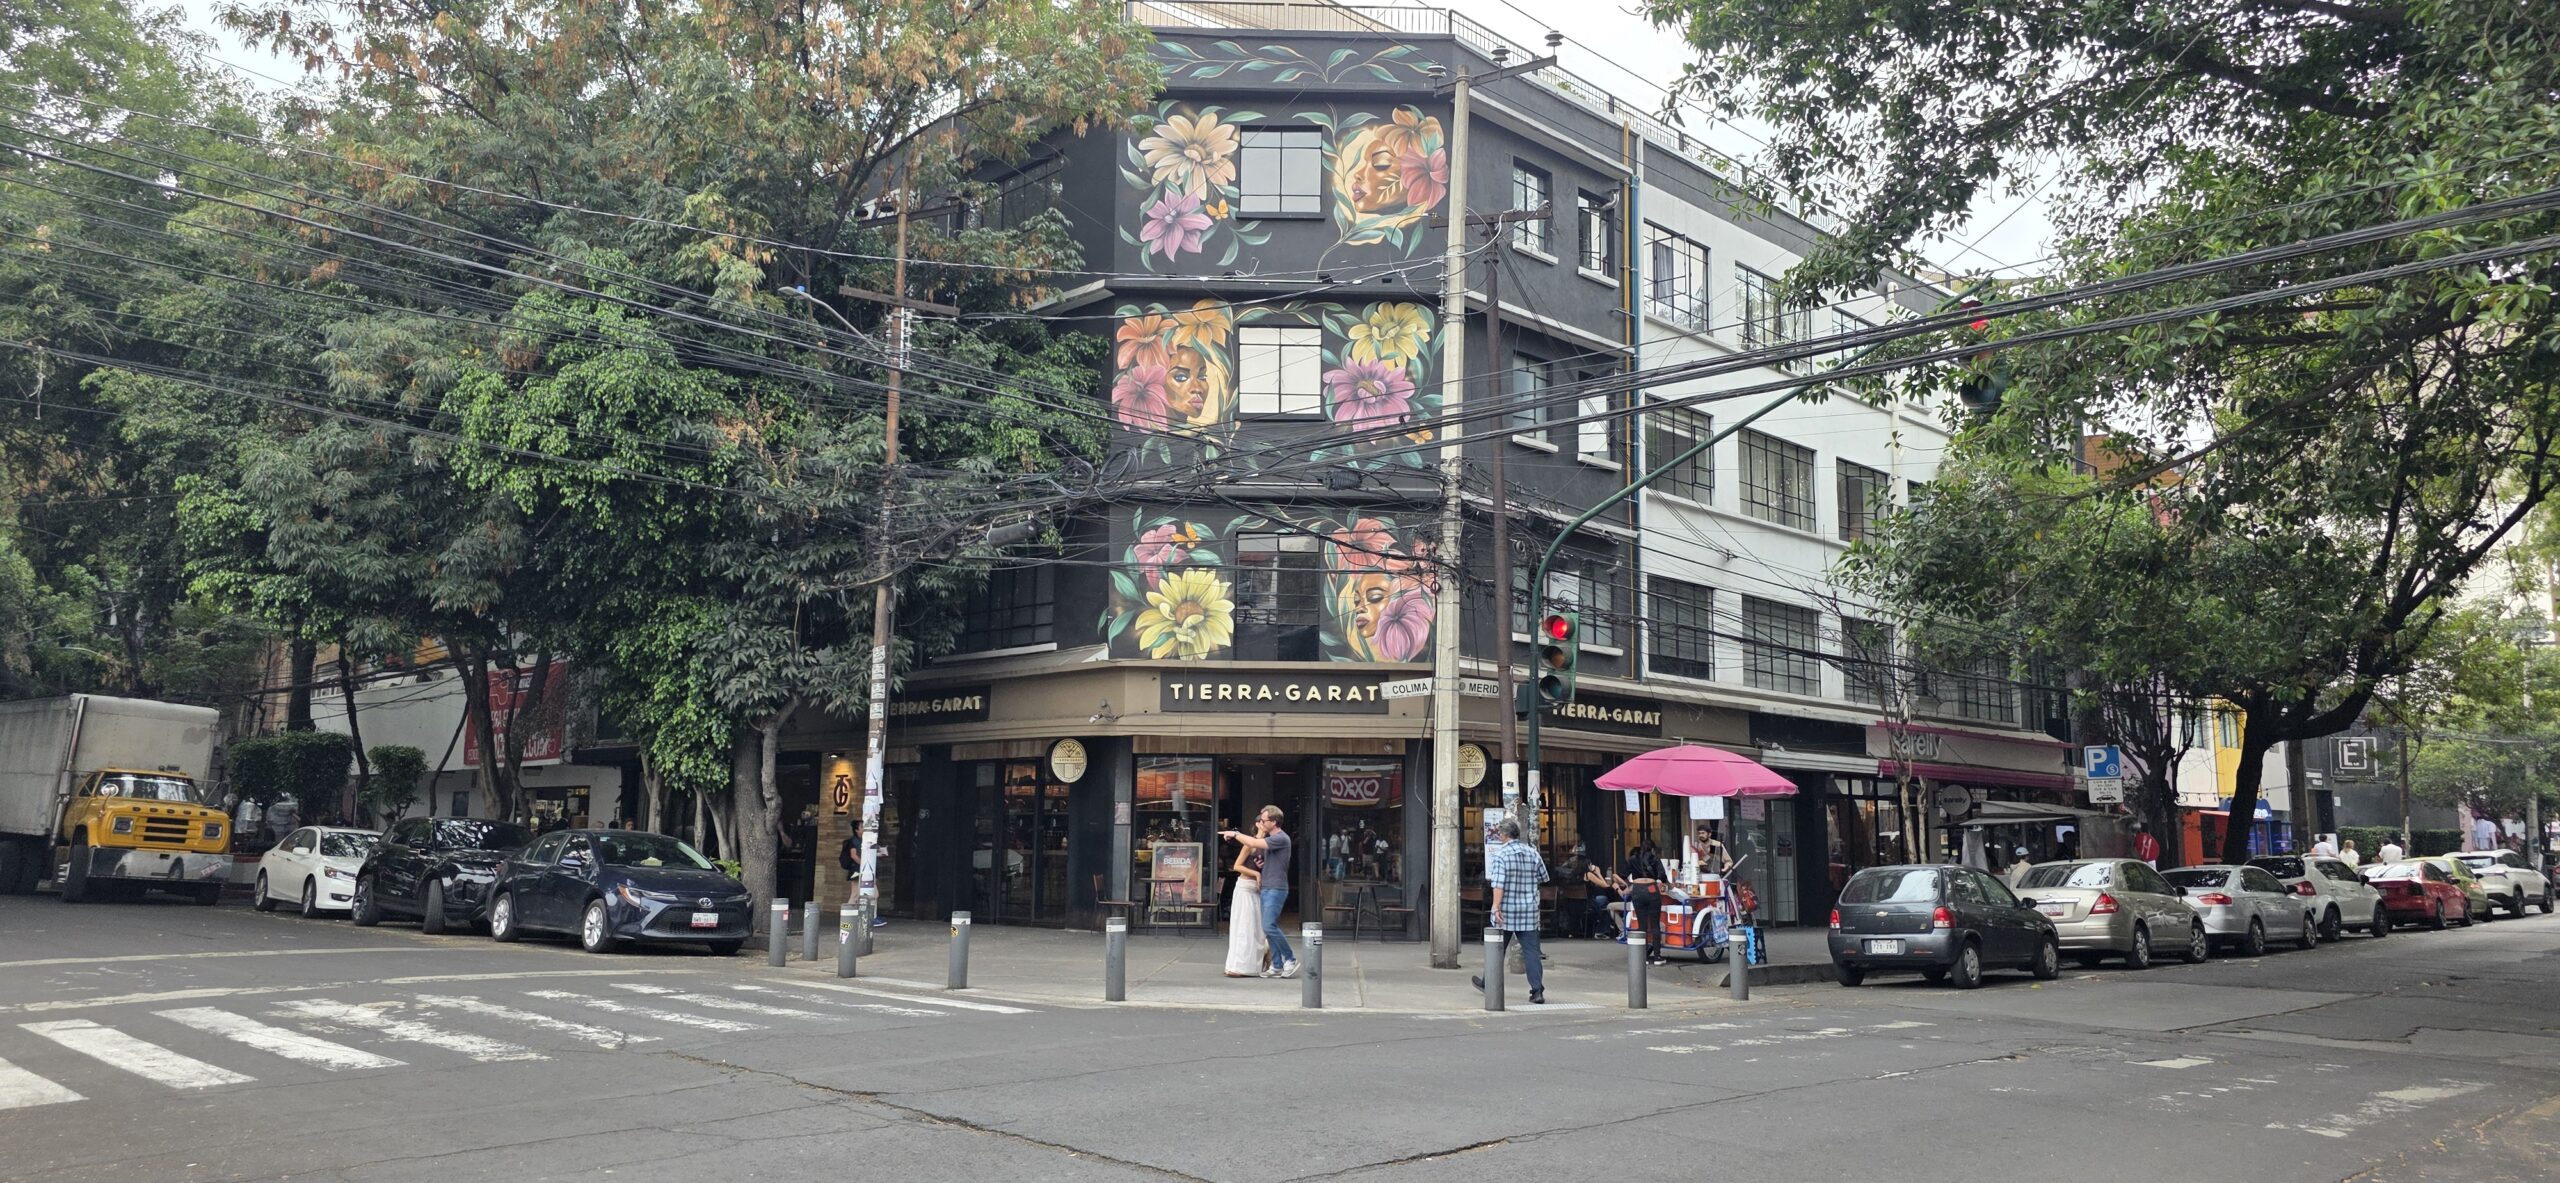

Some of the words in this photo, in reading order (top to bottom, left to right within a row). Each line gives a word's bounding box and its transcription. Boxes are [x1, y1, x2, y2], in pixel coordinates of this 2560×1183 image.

[1391, 682, 1429, 695] COLIMA
[1468, 682, 1499, 694] MERID
[2088, 749, 2107, 772] P
